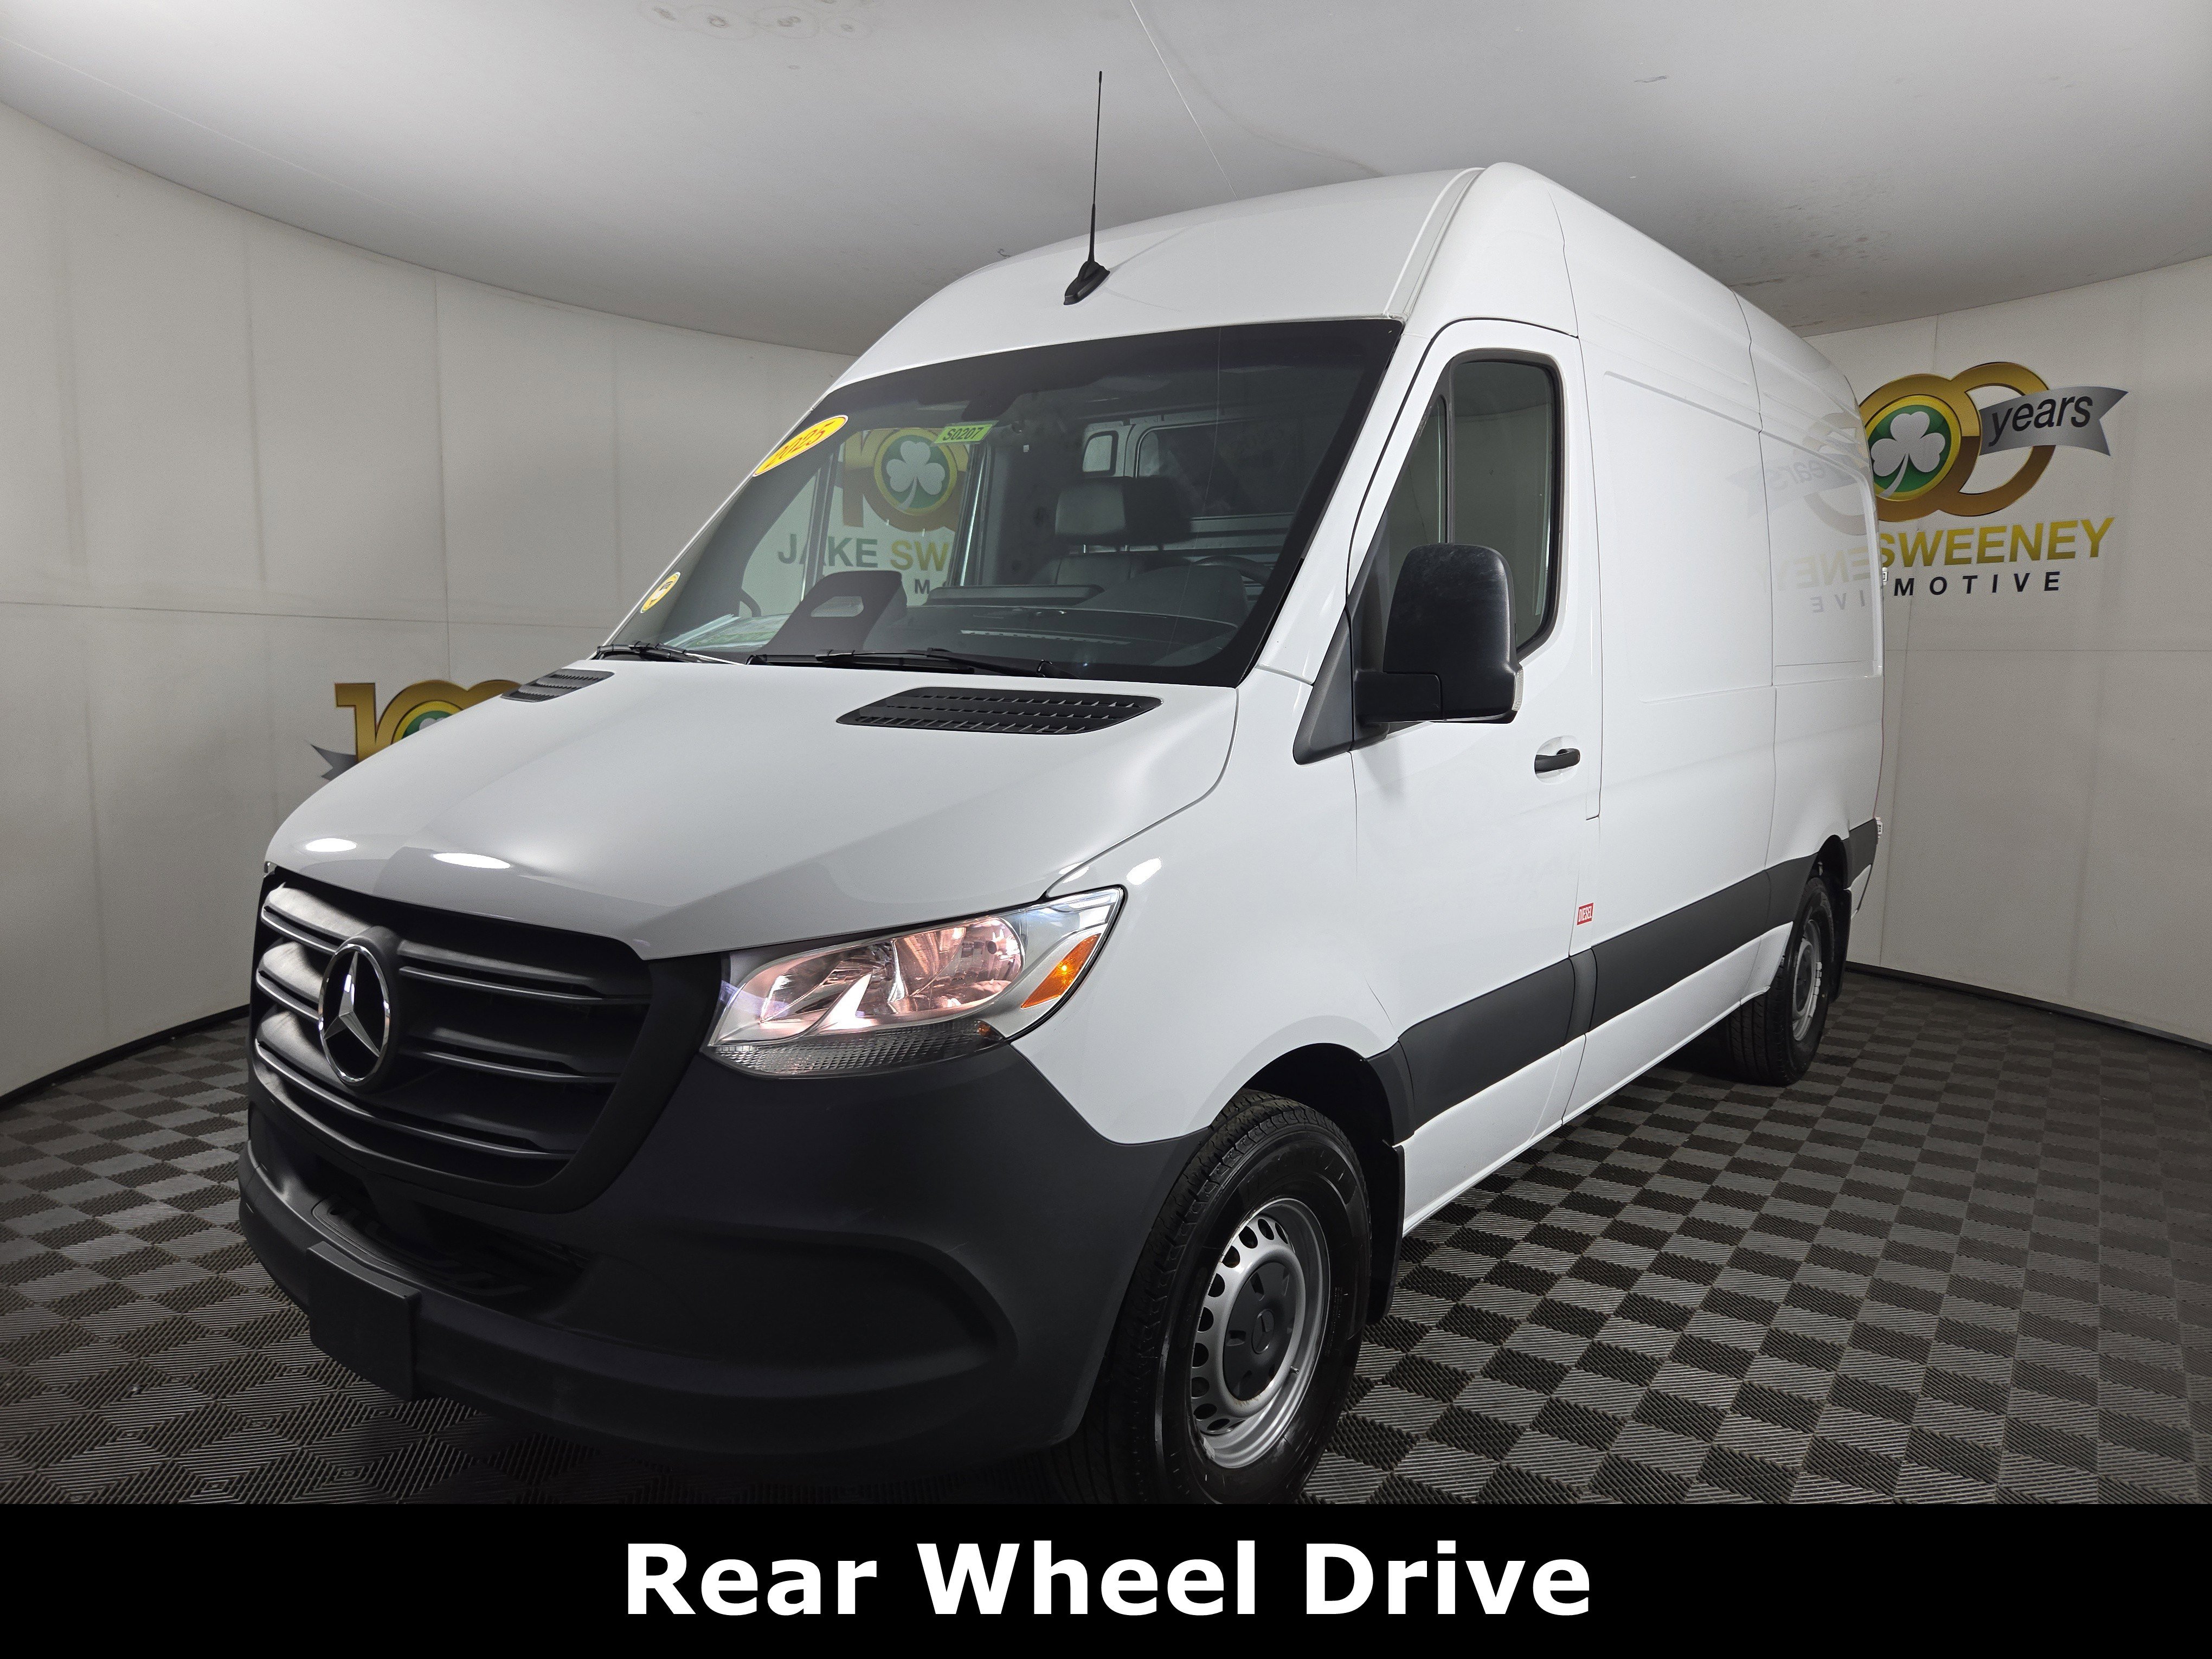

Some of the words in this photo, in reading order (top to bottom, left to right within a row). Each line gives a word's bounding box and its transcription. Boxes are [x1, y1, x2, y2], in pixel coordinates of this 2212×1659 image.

[942, 427, 985, 441] S0207
[1988, 395, 2093, 447] years
[763, 420, 836, 471] 2025
[777, 533, 878, 568] JKE
[1894, 571, 2060, 596] MOTIVE
[1578, 905, 1592, 922] DIESEL
